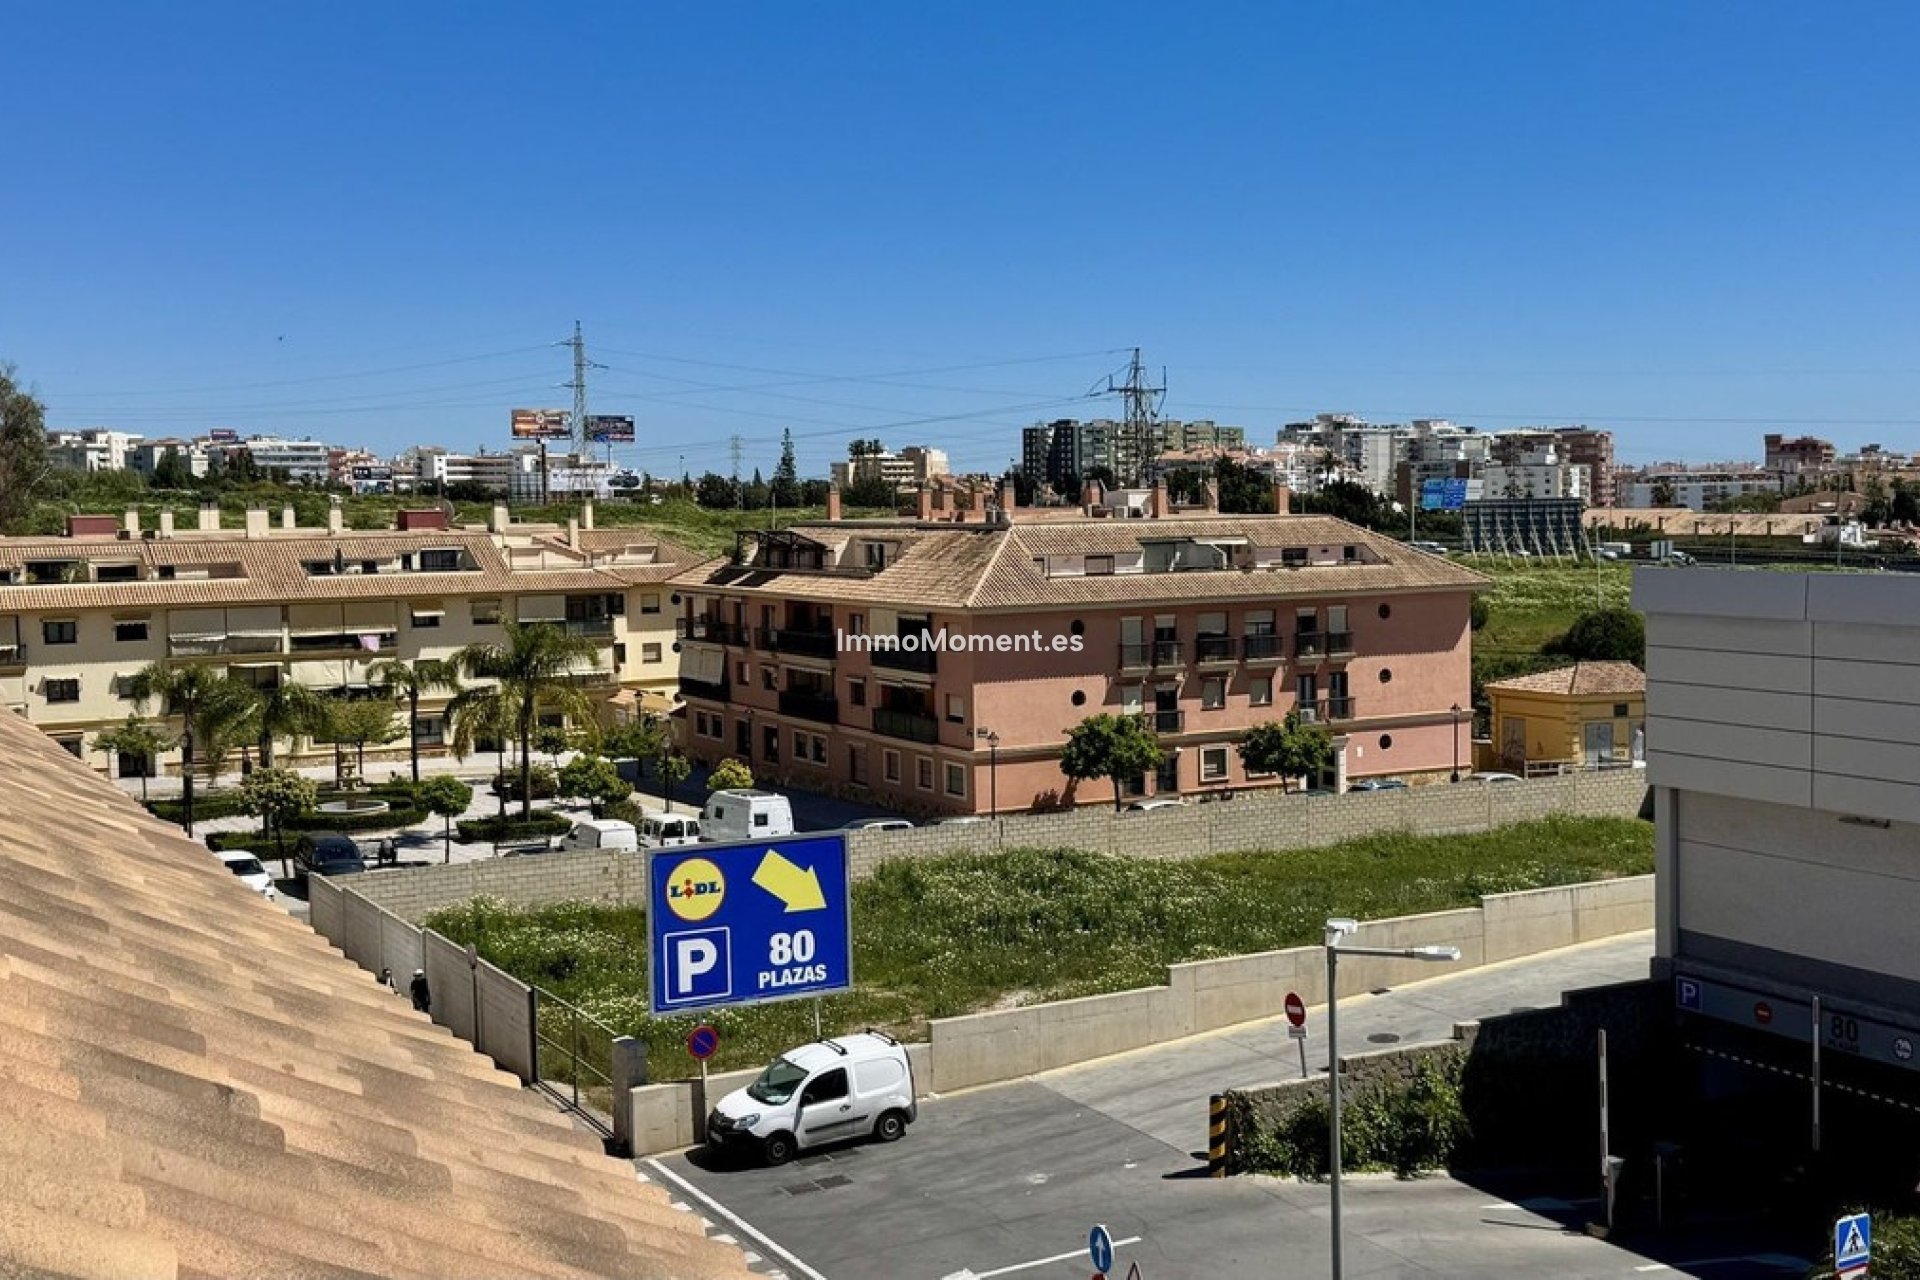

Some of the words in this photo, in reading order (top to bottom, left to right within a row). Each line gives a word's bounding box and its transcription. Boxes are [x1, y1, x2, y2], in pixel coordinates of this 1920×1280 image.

[769, 929, 815, 966] 80
[677, 938, 717, 993] P
[758, 964, 827, 989] PLAZAS
[1681, 981, 1696, 1004] P
[1831, 1015, 1858, 1042] 80
